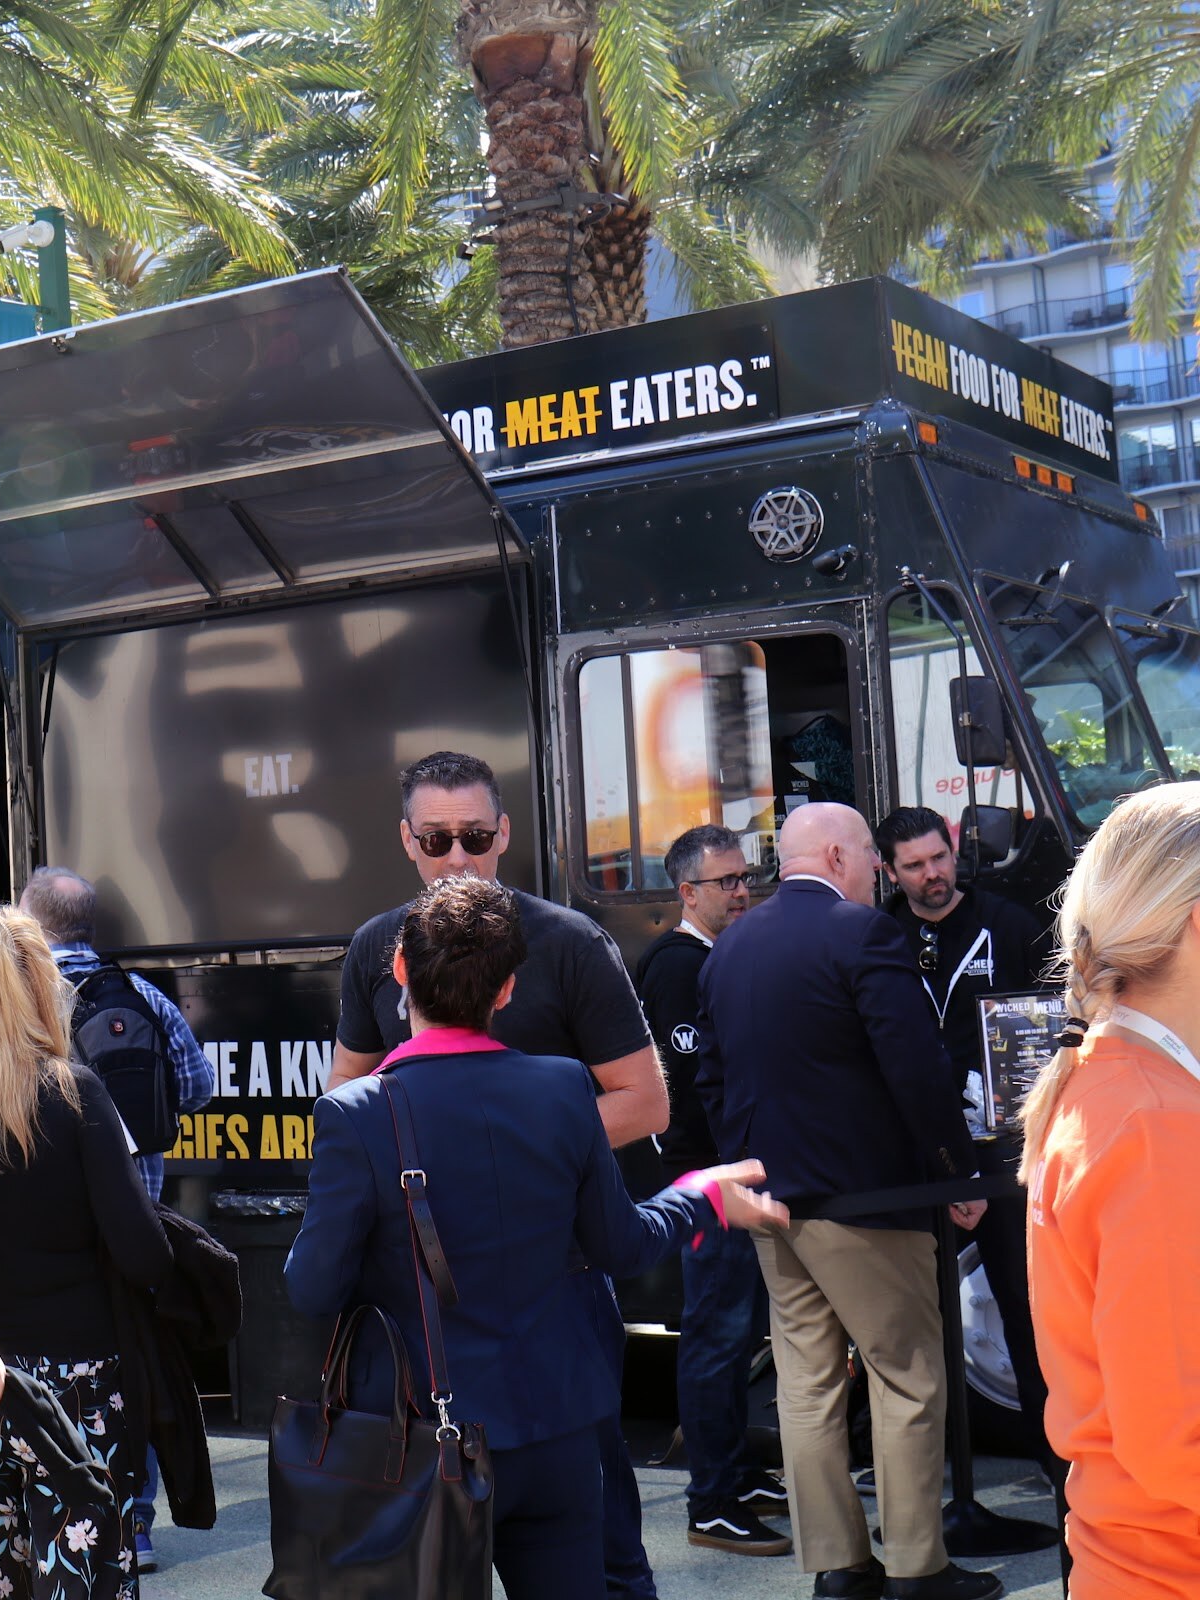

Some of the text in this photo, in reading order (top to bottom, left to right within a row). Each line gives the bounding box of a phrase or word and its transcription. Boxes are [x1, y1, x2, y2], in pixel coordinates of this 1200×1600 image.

[443, 406, 495, 454] OR
[500, 385, 603, 448] MEAT
[610, 359, 757, 430] EATERS.
[891, 319, 949, 391] VEGAN
[949, 345, 990, 408] FOOD
[991, 363, 1021, 422] FOR
[1021, 377, 1061, 438] MEAT
[1060, 395, 1111, 461] EATERS.
[245, 753, 300, 798] EAT.
[1033, 1000, 1062, 1014] MENU
[248, 1042, 272, 1098] A
